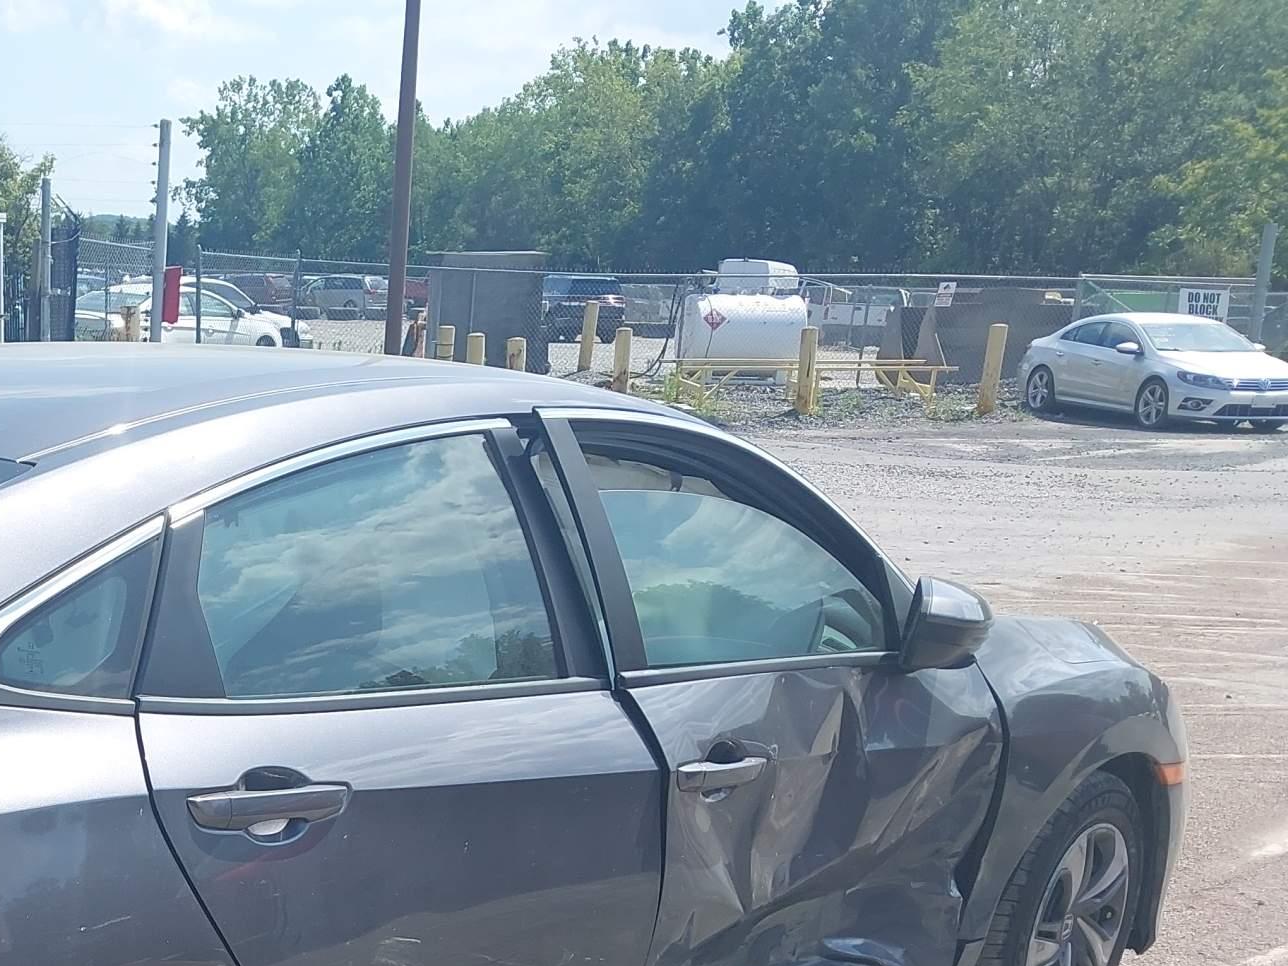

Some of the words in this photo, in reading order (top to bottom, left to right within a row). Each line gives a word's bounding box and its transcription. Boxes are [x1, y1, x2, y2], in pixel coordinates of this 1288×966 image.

[1188, 292, 1201, 303] DO
[1202, 292, 1221, 304] NOT
[1188, 303, 1219, 315] BLOCK
